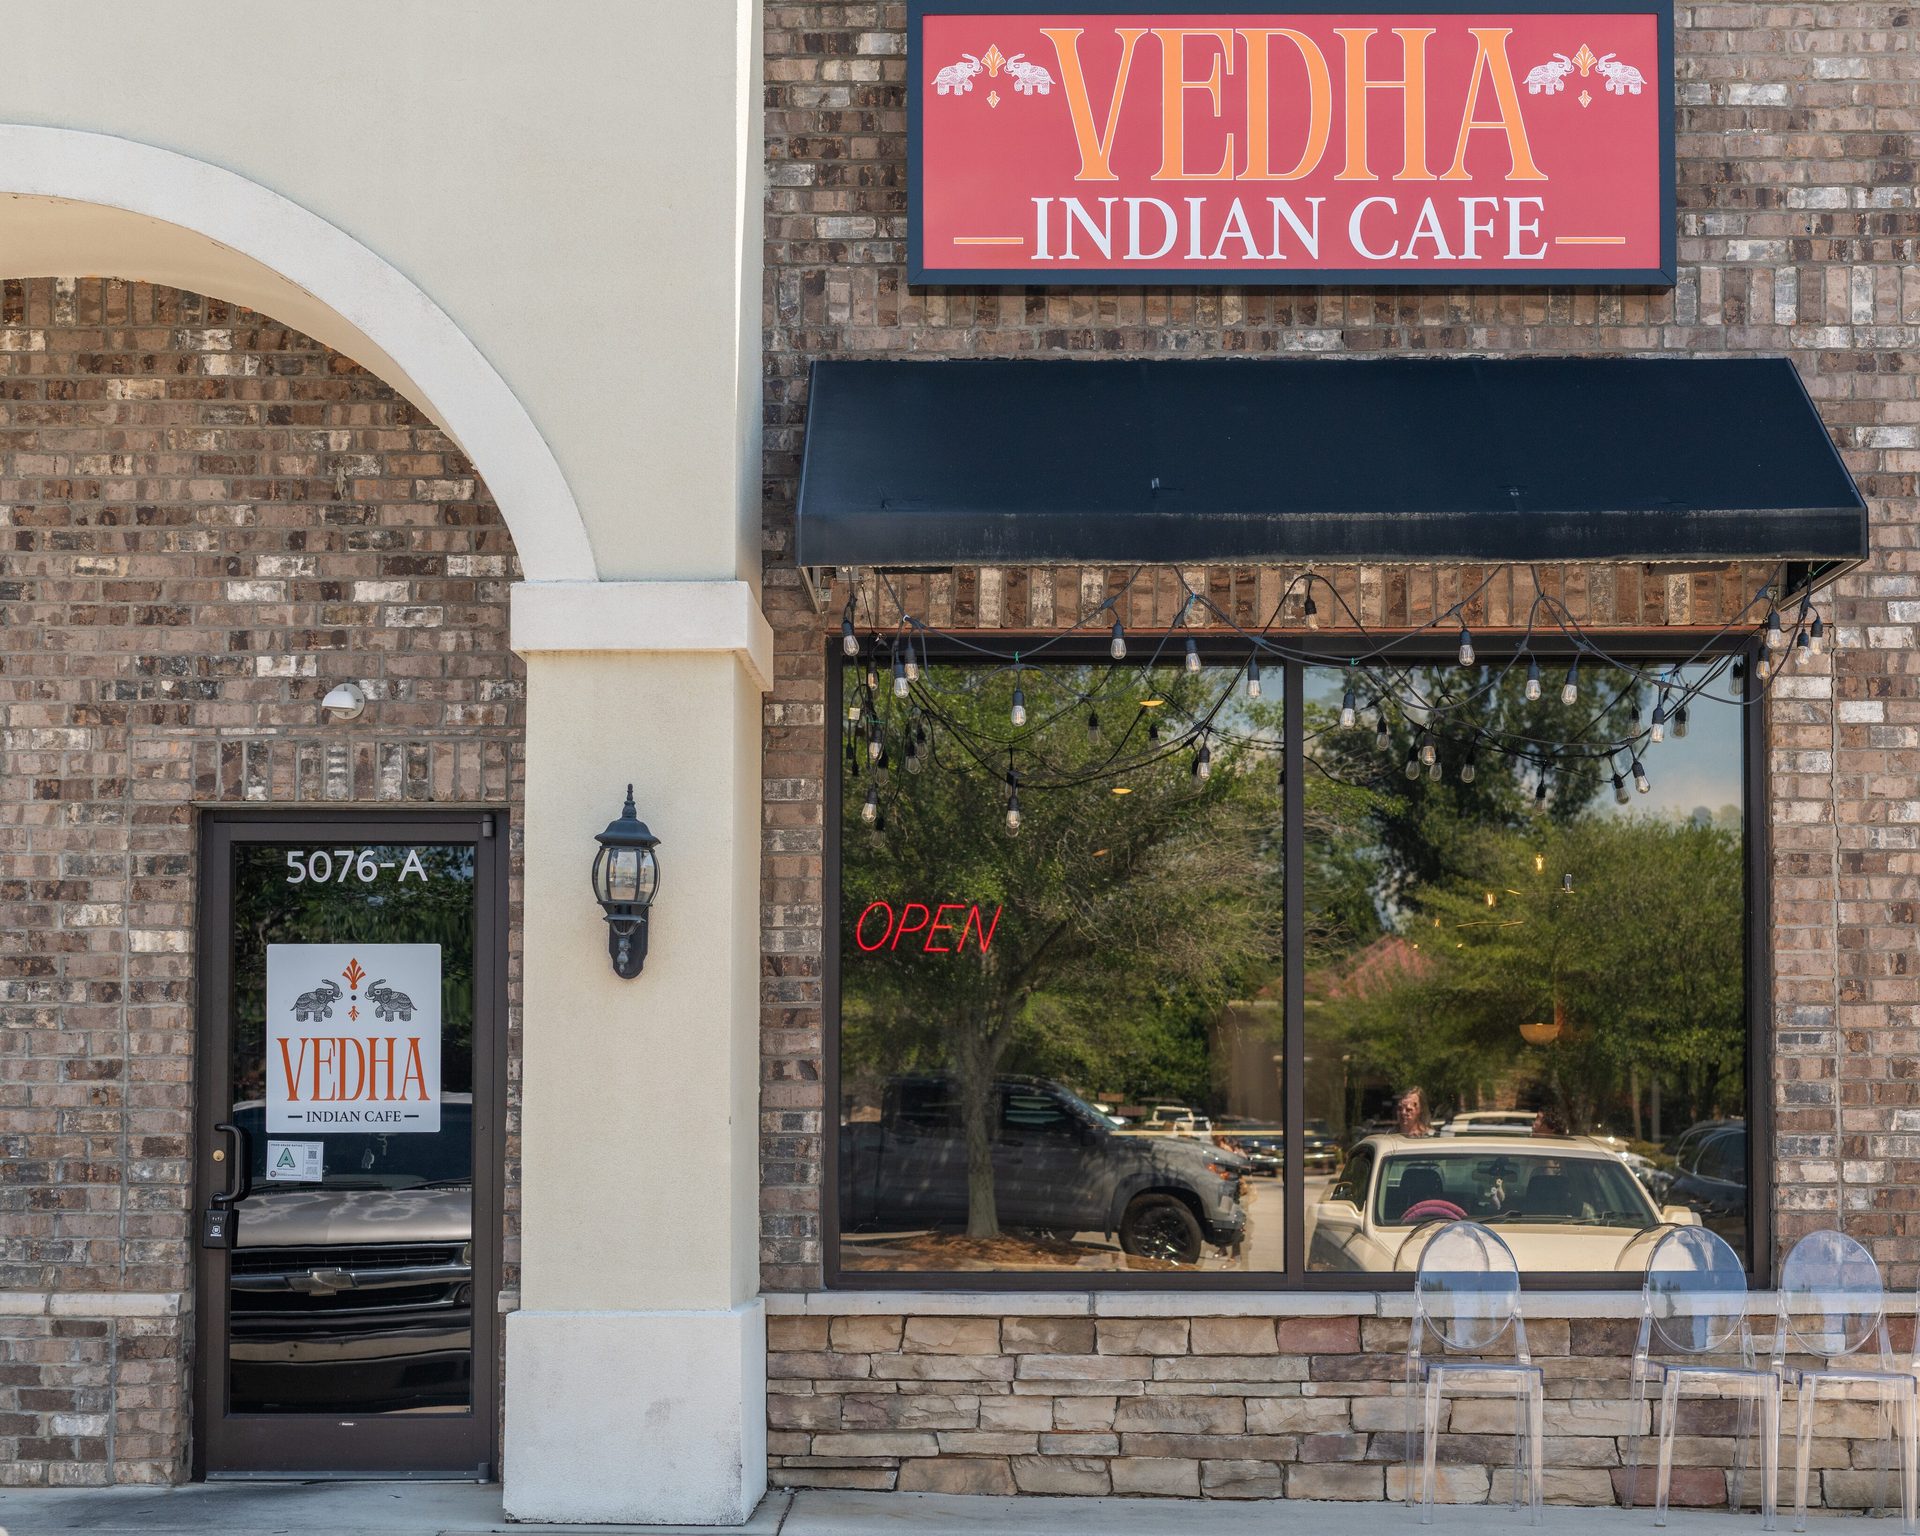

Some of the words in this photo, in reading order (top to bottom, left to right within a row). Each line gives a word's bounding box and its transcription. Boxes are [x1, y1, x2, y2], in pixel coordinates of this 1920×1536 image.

[1039, 27, 1548, 182] VEDHA
[1030, 196, 1326, 260] INDIAN
[1348, 196, 1548, 260] CAFE
[286, 849, 429, 884] 5076-A
[856, 901, 1002, 954] OPEN
[276, 1037, 430, 1102] VEDHA
[305, 1110, 361, 1123] INDIAN
[364, 1110, 402, 1123] CAFE
[277, 1147, 296, 1168] A
